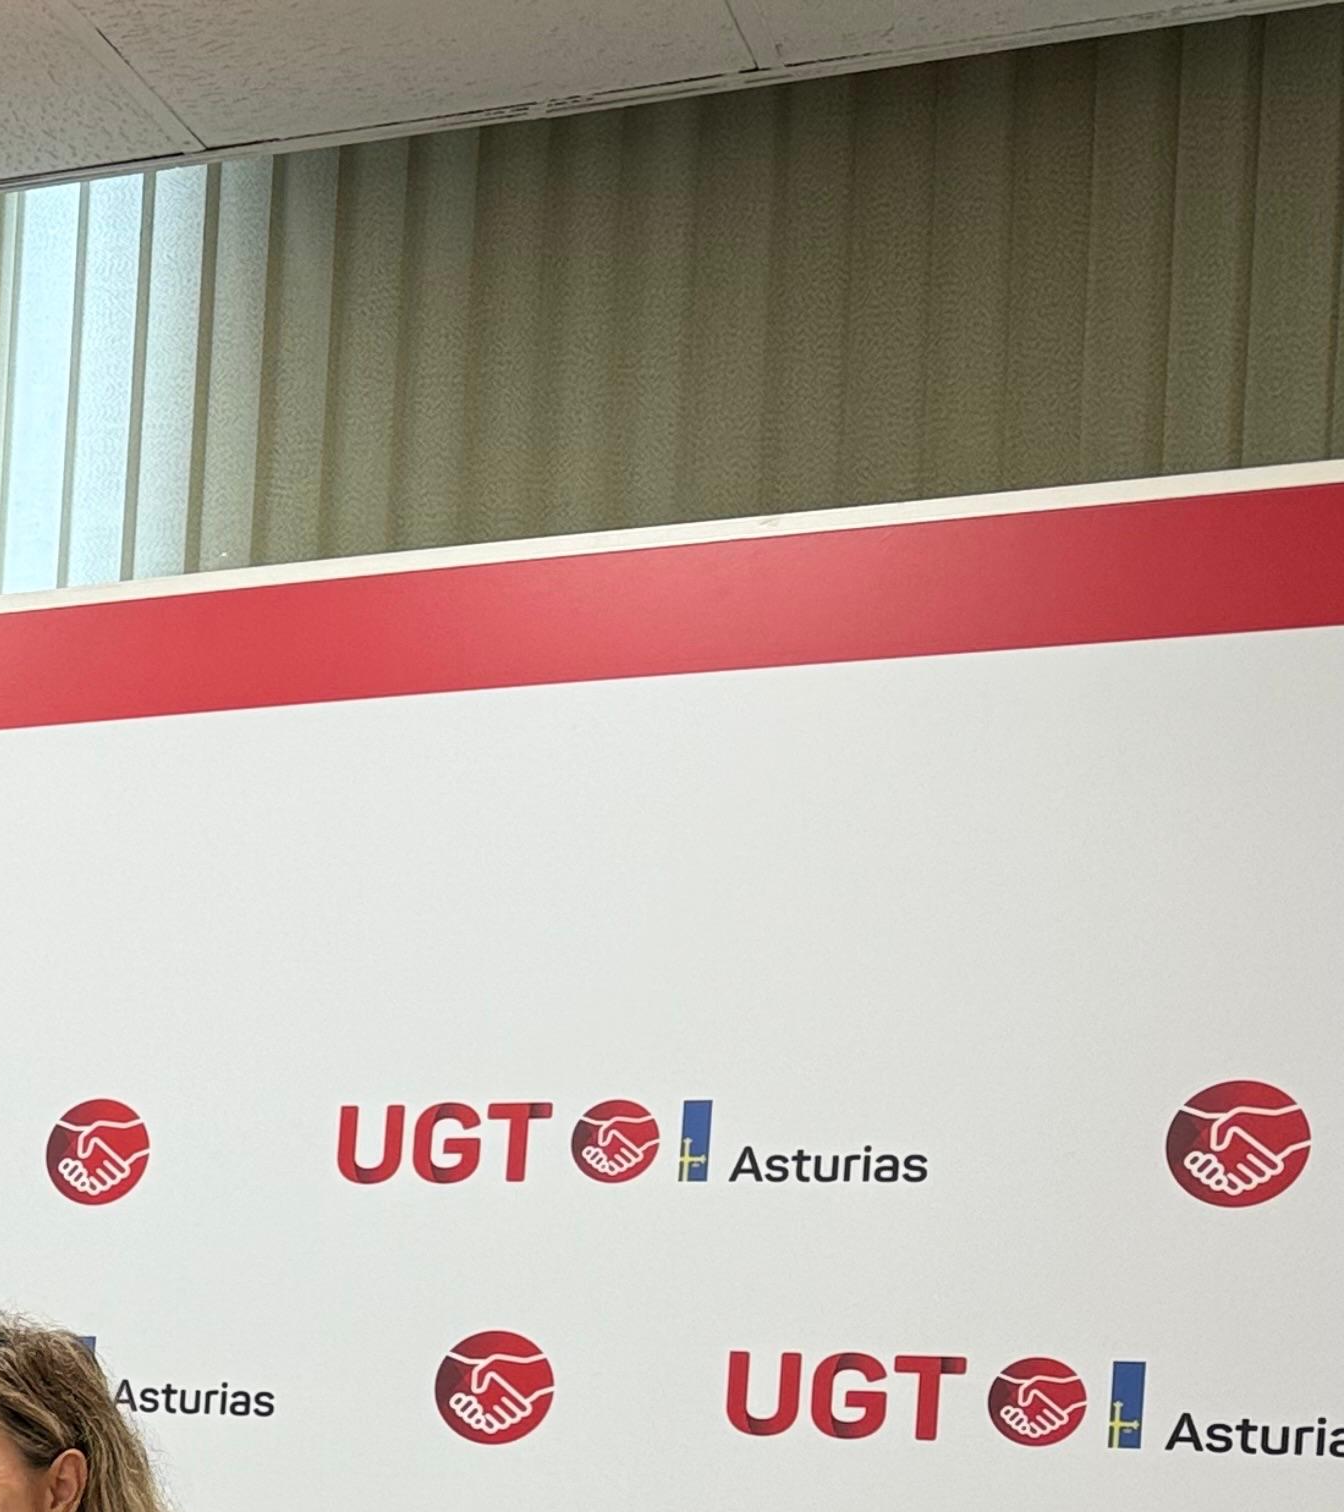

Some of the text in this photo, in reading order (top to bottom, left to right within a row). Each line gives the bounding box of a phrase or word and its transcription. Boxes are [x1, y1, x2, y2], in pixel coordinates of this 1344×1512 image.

[337, 1102, 927, 1184] UGT Asturias
[112, 1378, 275, 1417] Asturias
[726, 1351, 1344, 1458] UGT Asturia
